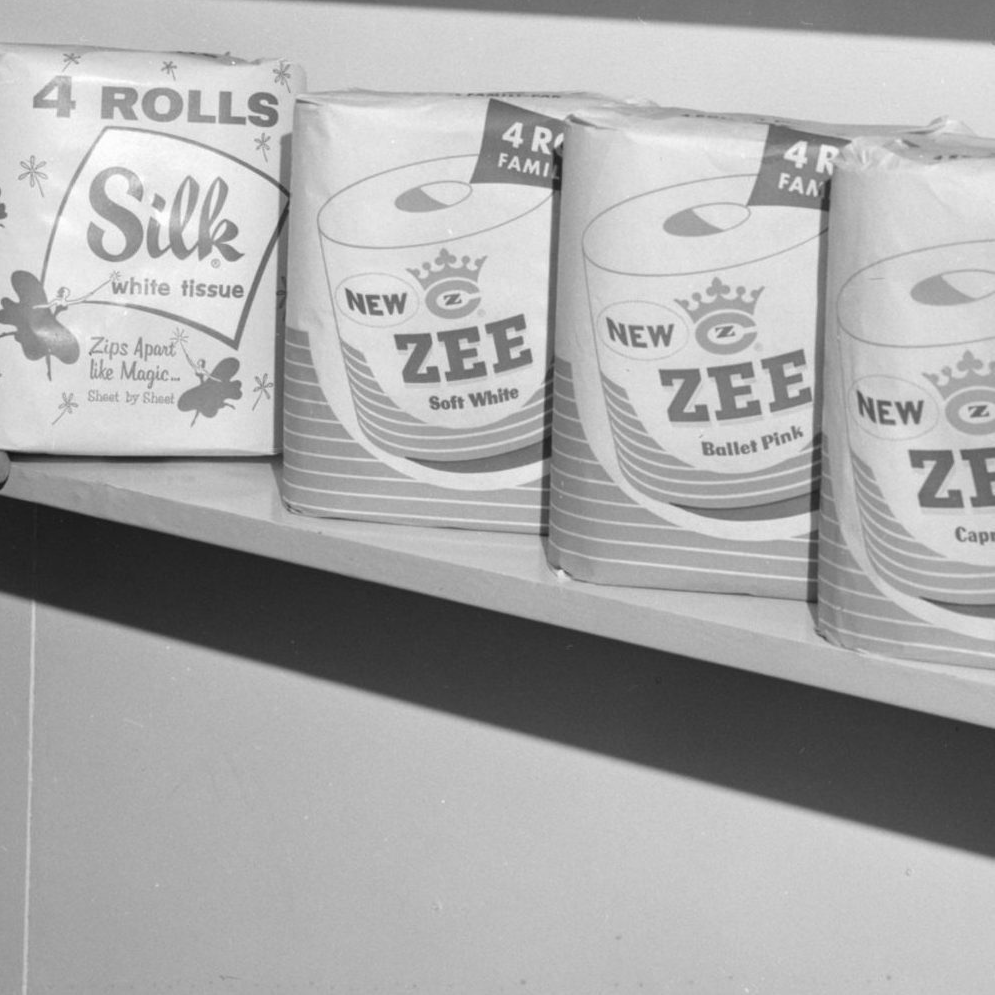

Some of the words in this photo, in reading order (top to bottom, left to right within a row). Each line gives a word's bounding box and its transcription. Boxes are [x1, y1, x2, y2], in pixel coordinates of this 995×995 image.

[32, 75, 77, 119] 4
[100, 85, 280, 129] ROLLS
[501, 121, 524, 149] 4
[783, 140, 808, 169] 4
[86, 165, 245, 263] Silk
[111, 277, 172, 297] white
[181, 279, 245, 299] tissue
[344, 287, 408, 316] NEW
[605, 316, 675, 349] NEW
[89, 336, 129, 358] Zips
[133, 339, 176, 360] Apart
[393, 314, 534, 385] ZEE
[90, 359, 115, 382] like
[87, 389, 121, 403] Sheet
[126, 390, 140, 407] by
[142, 391, 175, 405] Sheet
[429, 394, 466, 412] Soft
[468, 386, 519, 408] White
[658, 349, 813, 424] ZEE
[856, 390, 925, 426] NEW
[701, 436, 757, 457] Ballet
[762, 426, 804, 452] Pink
